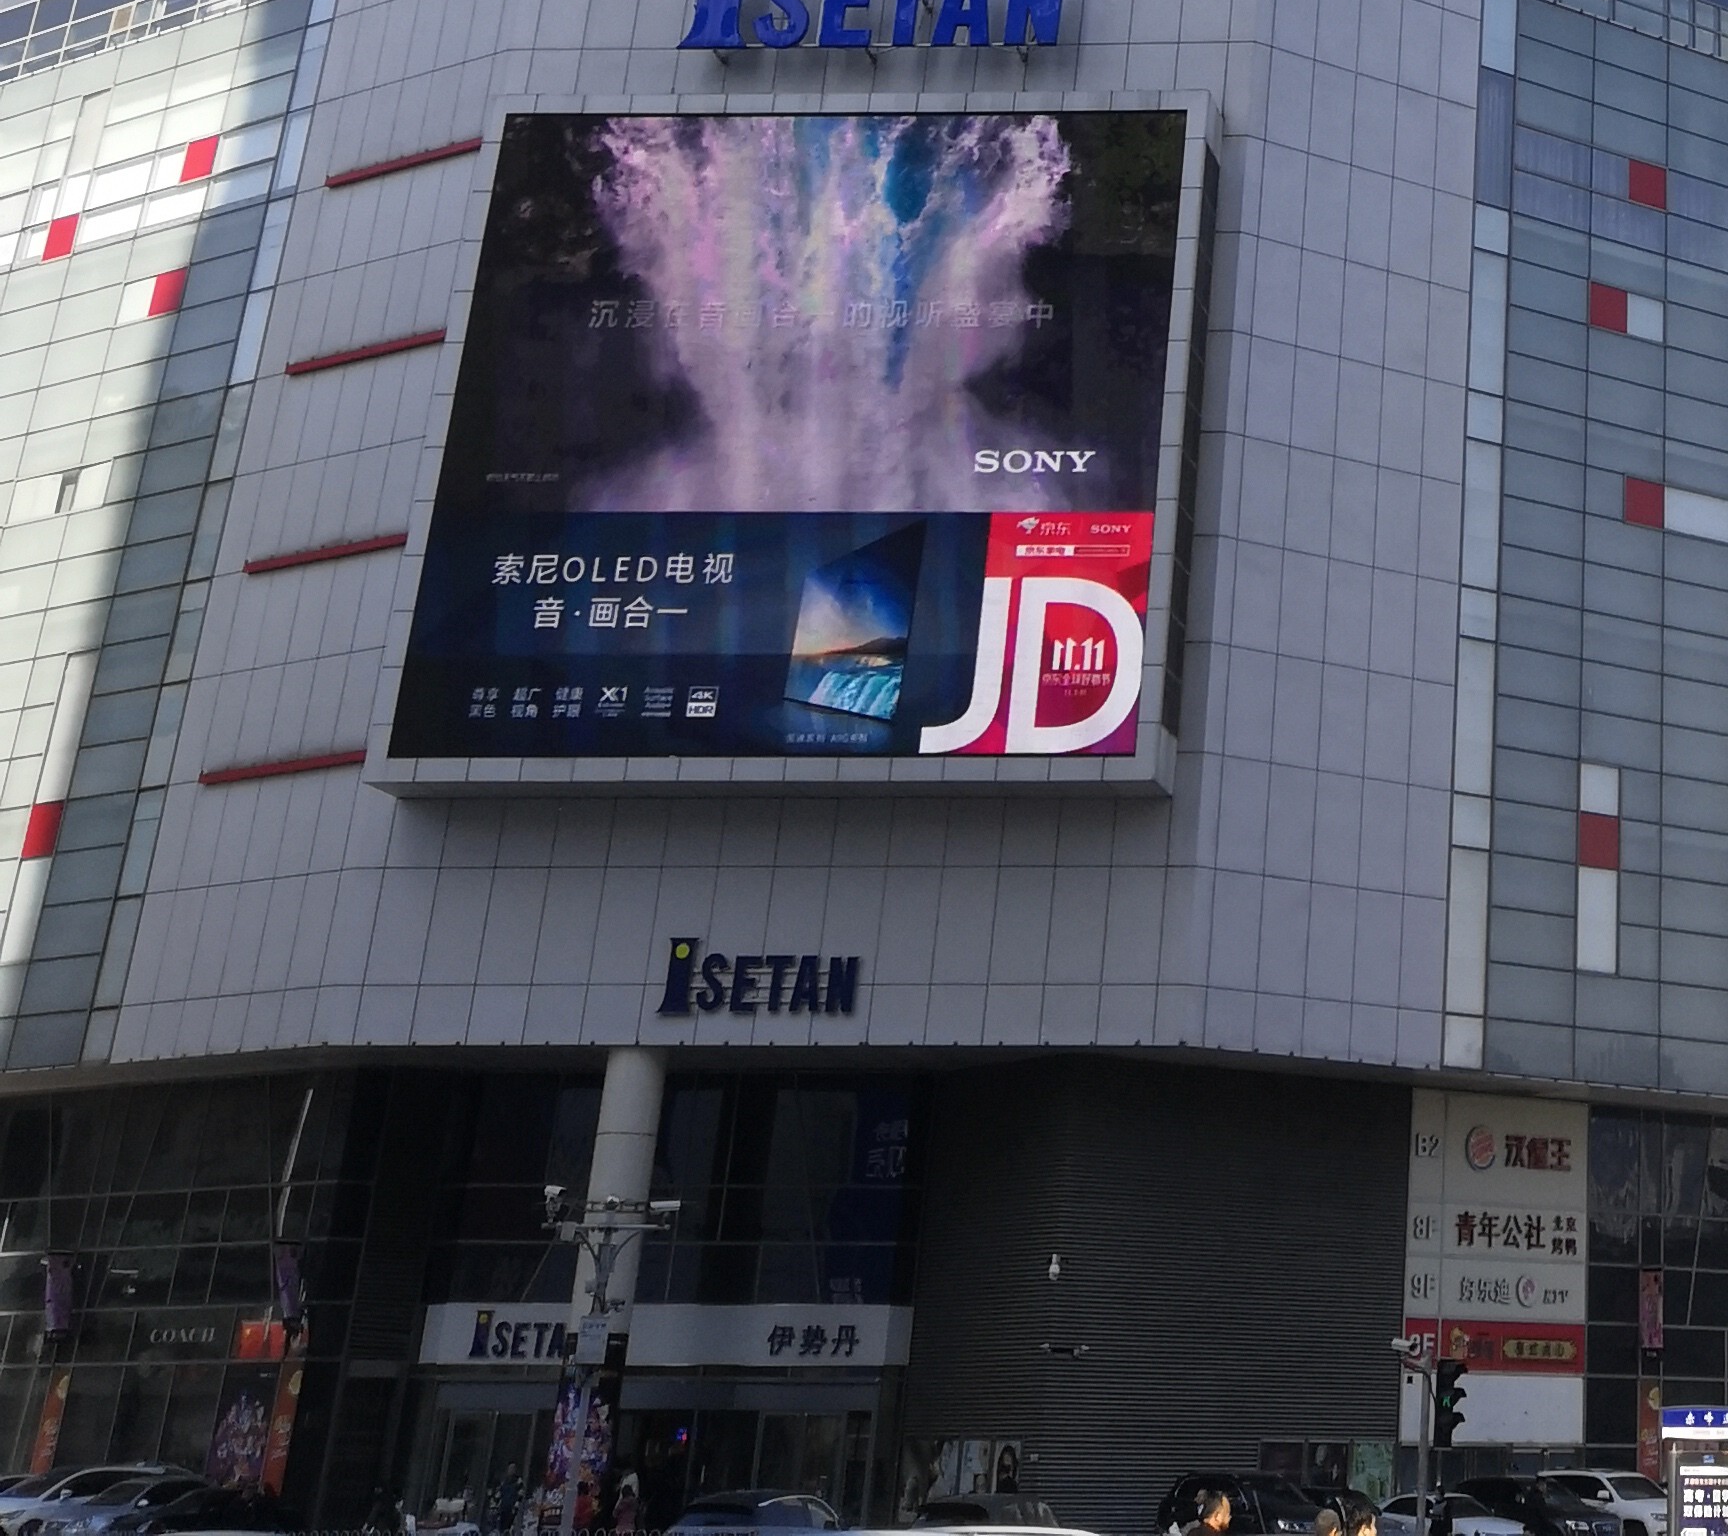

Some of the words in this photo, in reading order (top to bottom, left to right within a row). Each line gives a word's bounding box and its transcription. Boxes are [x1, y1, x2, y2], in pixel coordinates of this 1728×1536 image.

[973, 450, 1096, 473] SONY
[1090, 523, 1131, 534] SONY
[491, 553, 734, 584] 索尼OLED电视
[919, 577, 1143, 754] JD
[1052, 637, 1105, 670] 11.11
[688, 706, 714, 714] HDR
[691, 691, 714, 699] 4K
[656, 937, 859, 1014] ISETAN
[1456, 1211, 1546, 1249] 青年公社
[469, 1310, 568, 1358] ISETA
[767, 1324, 860, 1357] 伊势丹
